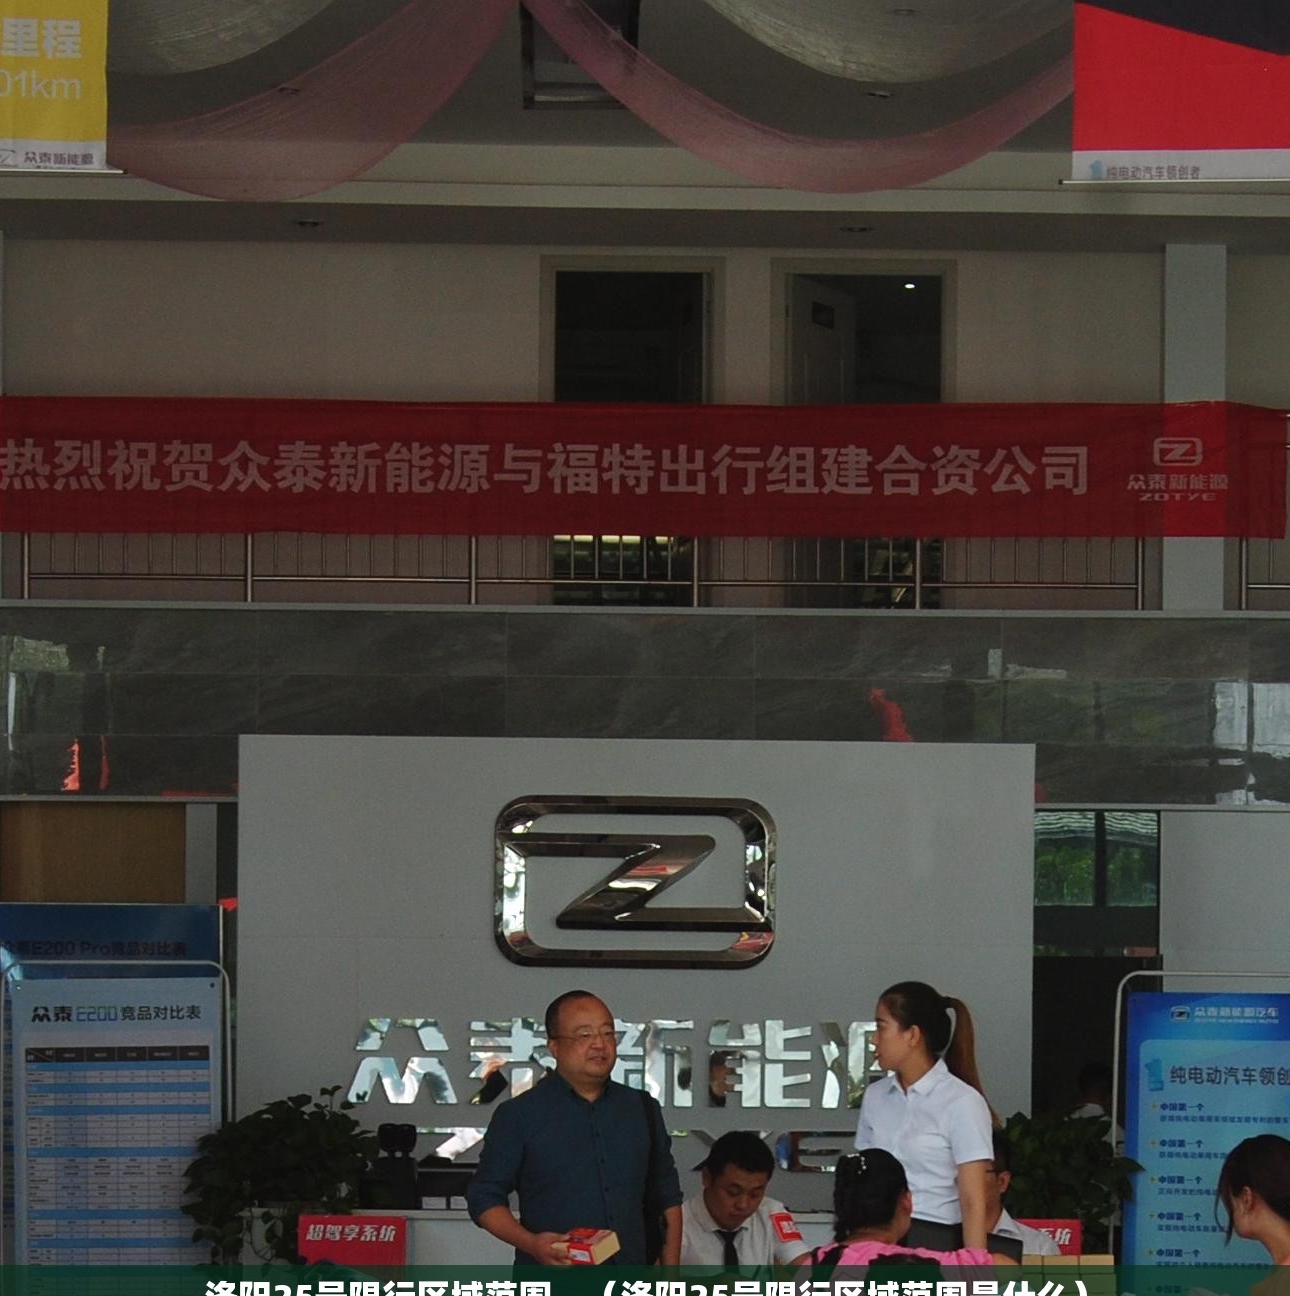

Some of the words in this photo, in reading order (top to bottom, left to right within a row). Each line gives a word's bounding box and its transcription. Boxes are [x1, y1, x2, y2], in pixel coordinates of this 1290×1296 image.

[1126, 474, 1229, 491] 众泰新能源
[306, 1223, 398, 1243] 超驾享系统
